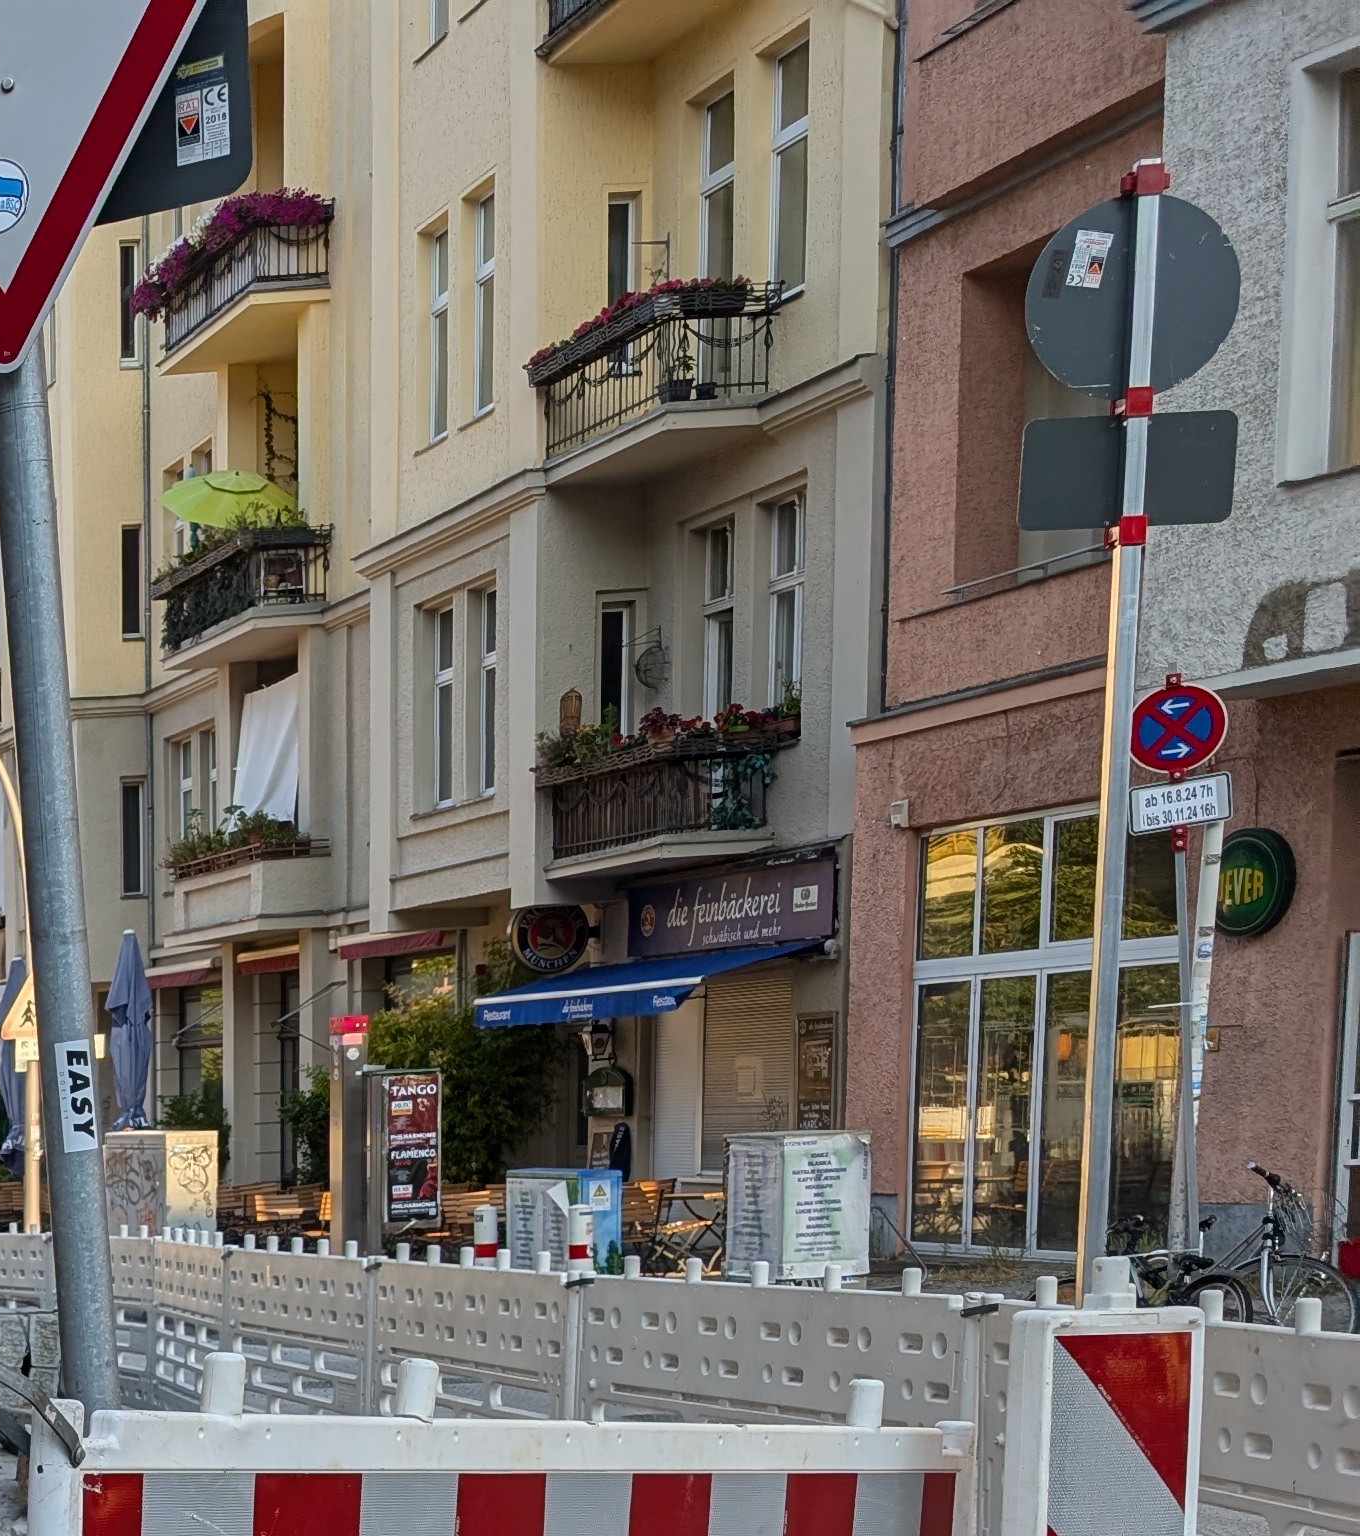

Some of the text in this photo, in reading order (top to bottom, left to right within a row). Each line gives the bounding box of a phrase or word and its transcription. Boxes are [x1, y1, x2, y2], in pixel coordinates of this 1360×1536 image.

[1145, 784, 1214, 808] ab 16.8.24 7h
[1146, 802, 1217, 827] bis 30.11.24 16h
[667, 877, 781, 947] die feinbäckerei
[744, 921, 760, 940] und
[761, 918, 781, 937] mehr
[66, 1050, 95, 1140] EASY
[391, 1084, 437, 1097] TANGO
[391, 1149, 436, 1160] FLAMENCO
